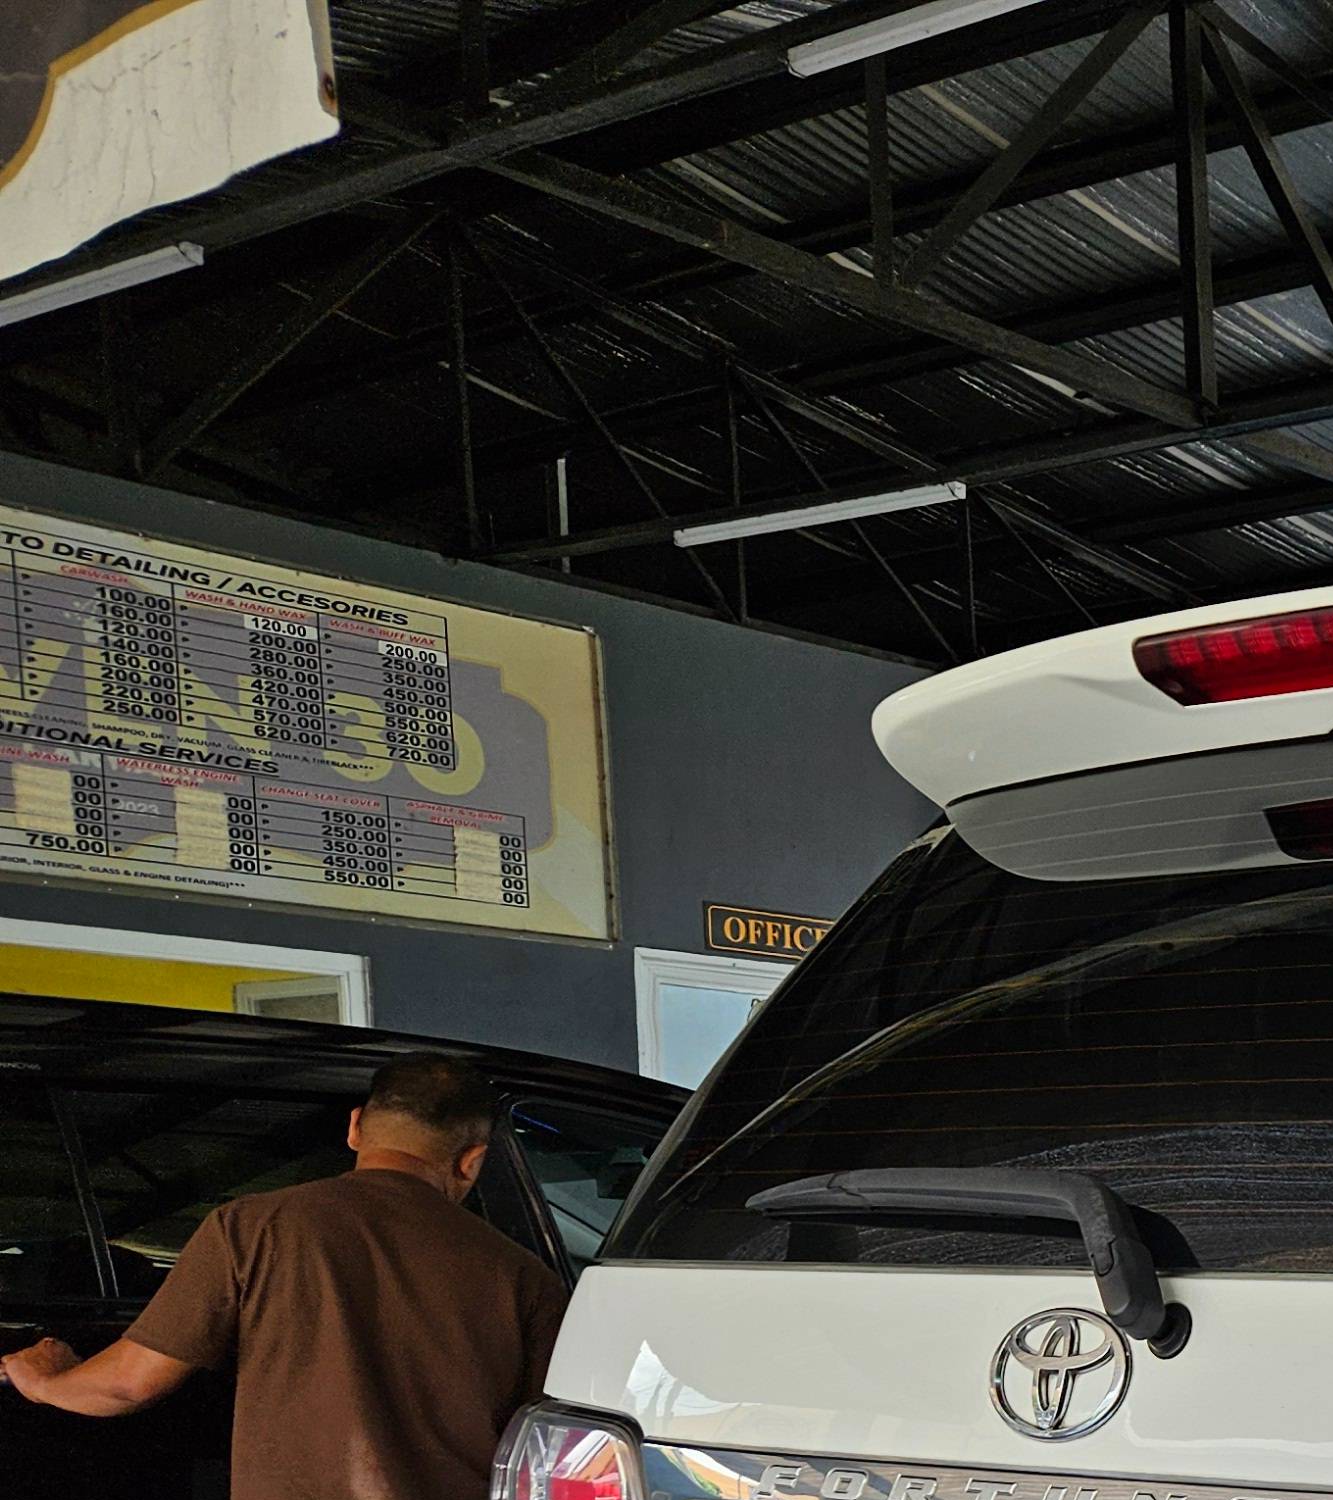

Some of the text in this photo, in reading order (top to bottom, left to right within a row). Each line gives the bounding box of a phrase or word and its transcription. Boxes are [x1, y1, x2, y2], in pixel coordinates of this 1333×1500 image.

[52, 542, 211, 587] DETAILING
[237, 582, 409, 625] ACCESORIES
[58, 565, 129, 584] CARWASH
[97, 586, 171, 611] 100.00
[185, 590, 223, 603] WASH
[240, 601, 275, 614] HAND
[278, 607, 307, 620] WAX
[97, 603, 172, 627] 160.00
[98, 619, 173, 643] 120.00
[251, 617, 307, 637] 120.00
[329, 619, 364, 632] WASH
[409, 634, 436, 647] WAX
[99, 635, 174, 659] 140.00
[249, 631, 317, 655] 200.00
[385, 643, 437, 665] 200.00
[101, 651, 175, 675] 160.00
[249, 647, 318, 670] 280.00
[381, 657, 446, 679] 250.00
[101, 667, 176, 690] 200.00
[250, 662, 319, 686] 360.00
[382, 672, 446, 694] 350.00
[102, 683, 177, 706] 220.00
[251, 678, 320, 701] 420.00
[383, 687, 447, 708] 450.00
[103, 699, 178, 723] 250.00
[252, 694, 321, 716] 470.00
[384, 702, 448, 723] 500.00
[253, 709, 322, 732] 570.00
[385, 716, 449, 737] 550.00
[0, 720, 130, 752] ITIONAL
[140, 742, 279, 774] SERVICES
[254, 725, 323, 747] 620.00
[386, 731, 450, 752] 620.00
[28, 750, 70, 764] WASH
[386, 745, 451, 767] 720.00
[116, 757, 190, 777] WATERLESS
[193, 767, 239, 783] ENGINE
[160, 776, 199, 788] WASH
[343, 797, 381, 809] COVER
[321, 810, 386, 829] 150.00
[25, 832, 105, 854] 750.00
[321, 825, 387, 844] 250.00
[322, 839, 388, 859] 350.00
[88, 866, 121, 875] GLASS
[133, 871, 172, 882] ENGINE
[322, 855, 389, 873] 450.00
[324, 870, 389, 888] 550.00
